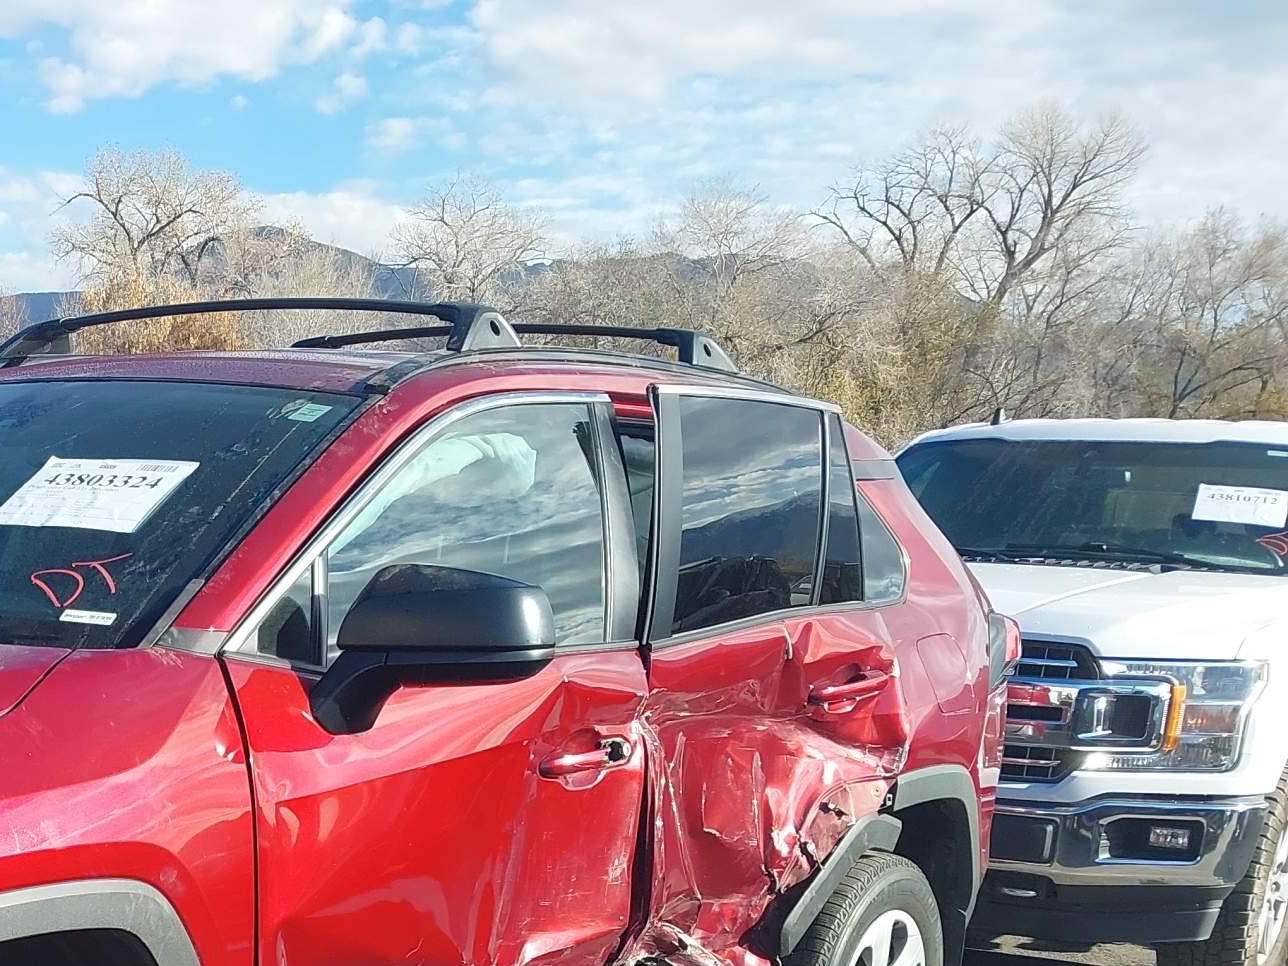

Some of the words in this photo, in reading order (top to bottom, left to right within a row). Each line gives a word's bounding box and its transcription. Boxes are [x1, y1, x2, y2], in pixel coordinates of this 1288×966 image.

[44, 473, 164, 489] 43803324
[1207, 493, 1278, 505] 43810712
[31, 552, 133, 608] DT
